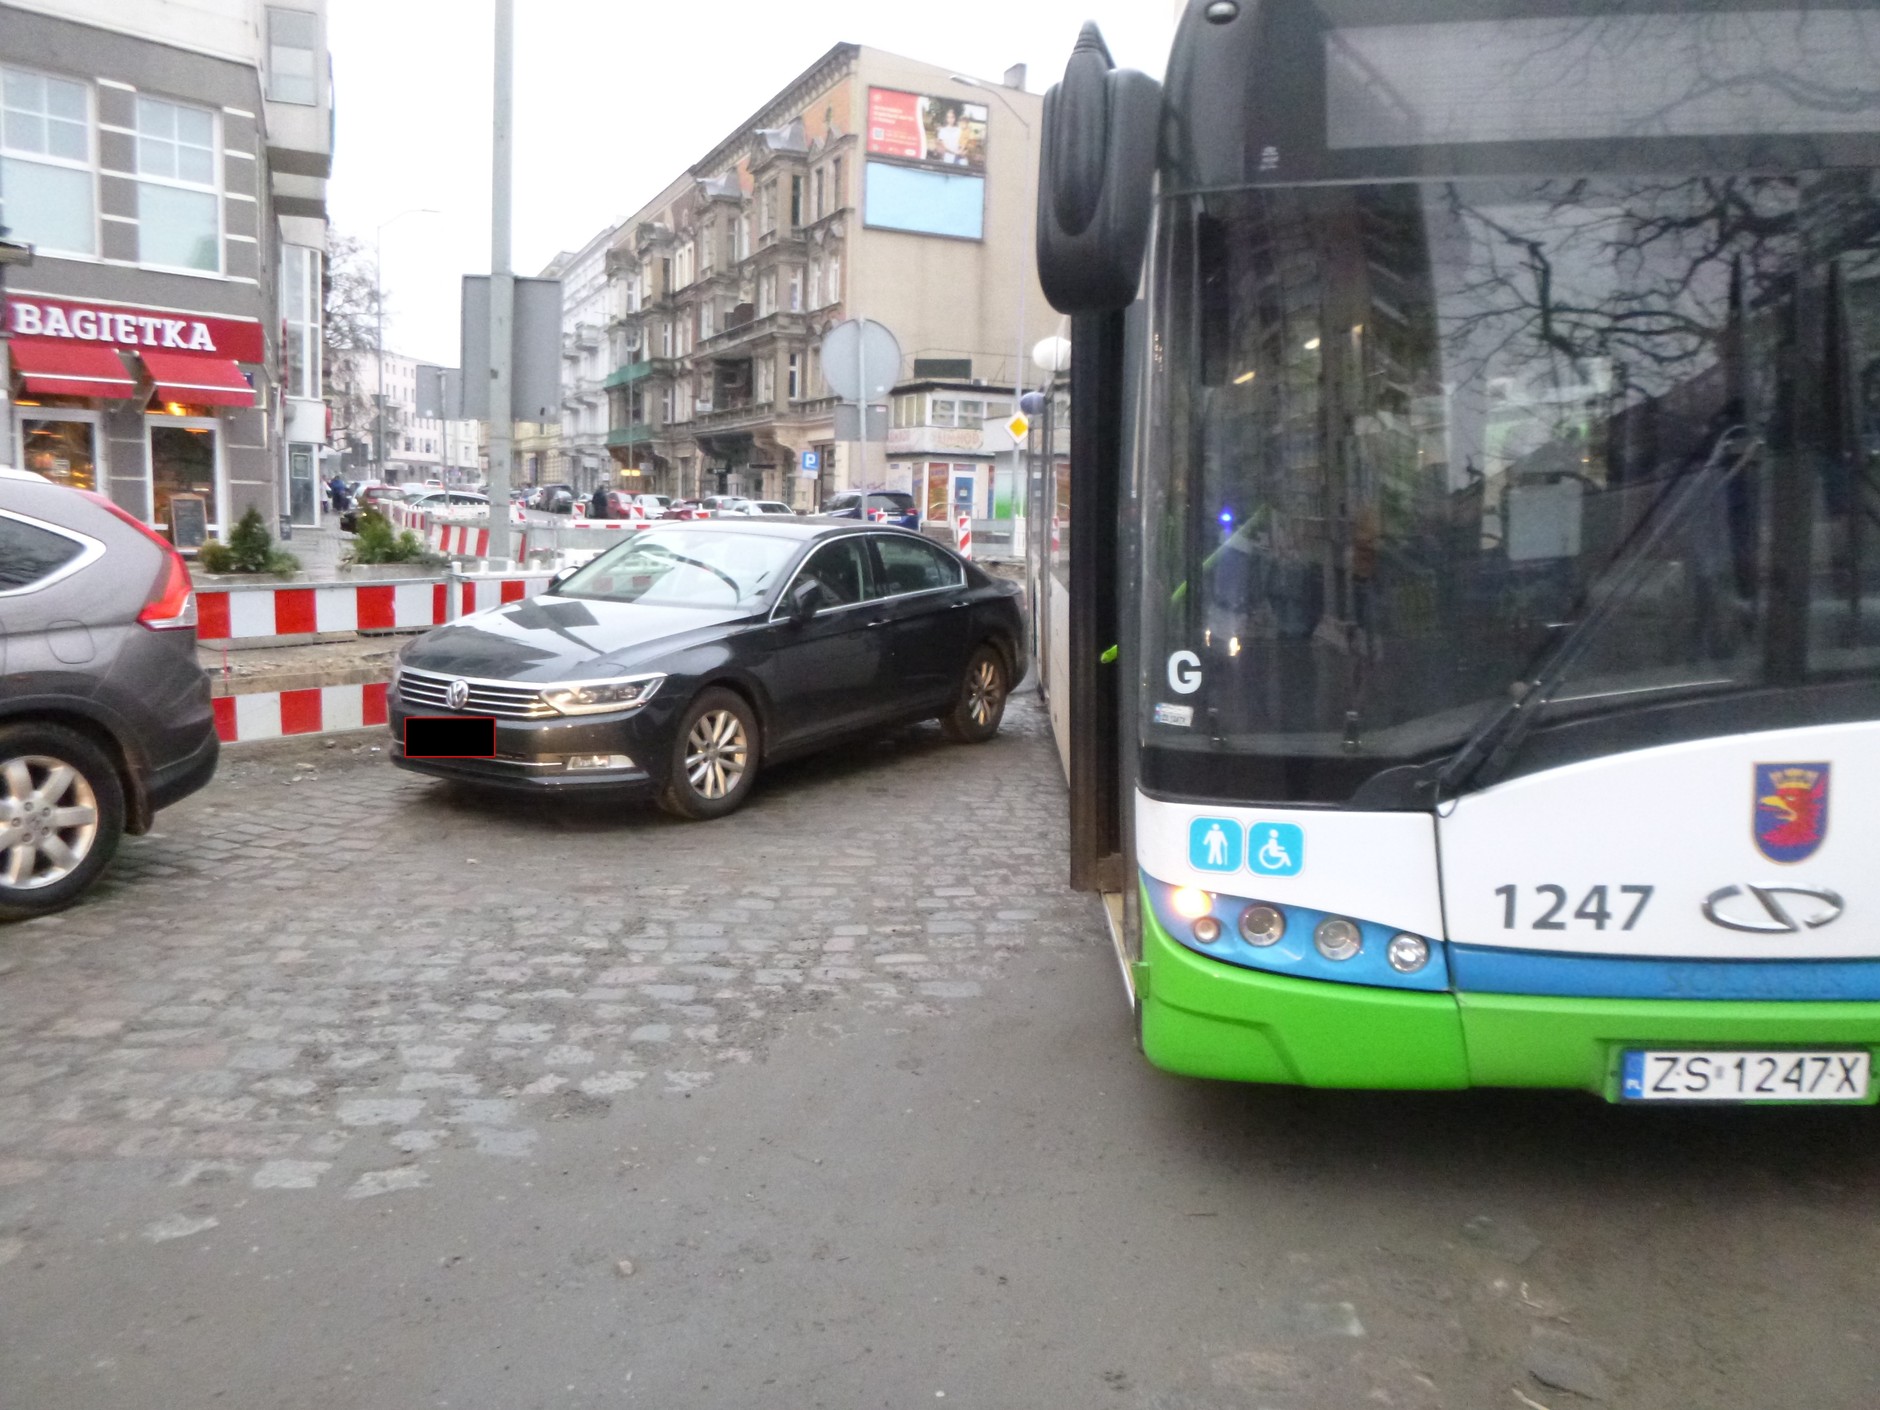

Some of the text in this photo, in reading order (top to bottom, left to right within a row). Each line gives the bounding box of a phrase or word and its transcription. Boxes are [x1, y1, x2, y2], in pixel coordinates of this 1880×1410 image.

[13, 303, 217, 351] BAGIETKA
[1167, 650, 1203, 694] G
[1494, 883, 1655, 931] 1247
[1652, 1056, 1861, 1093] ZS 1247X
